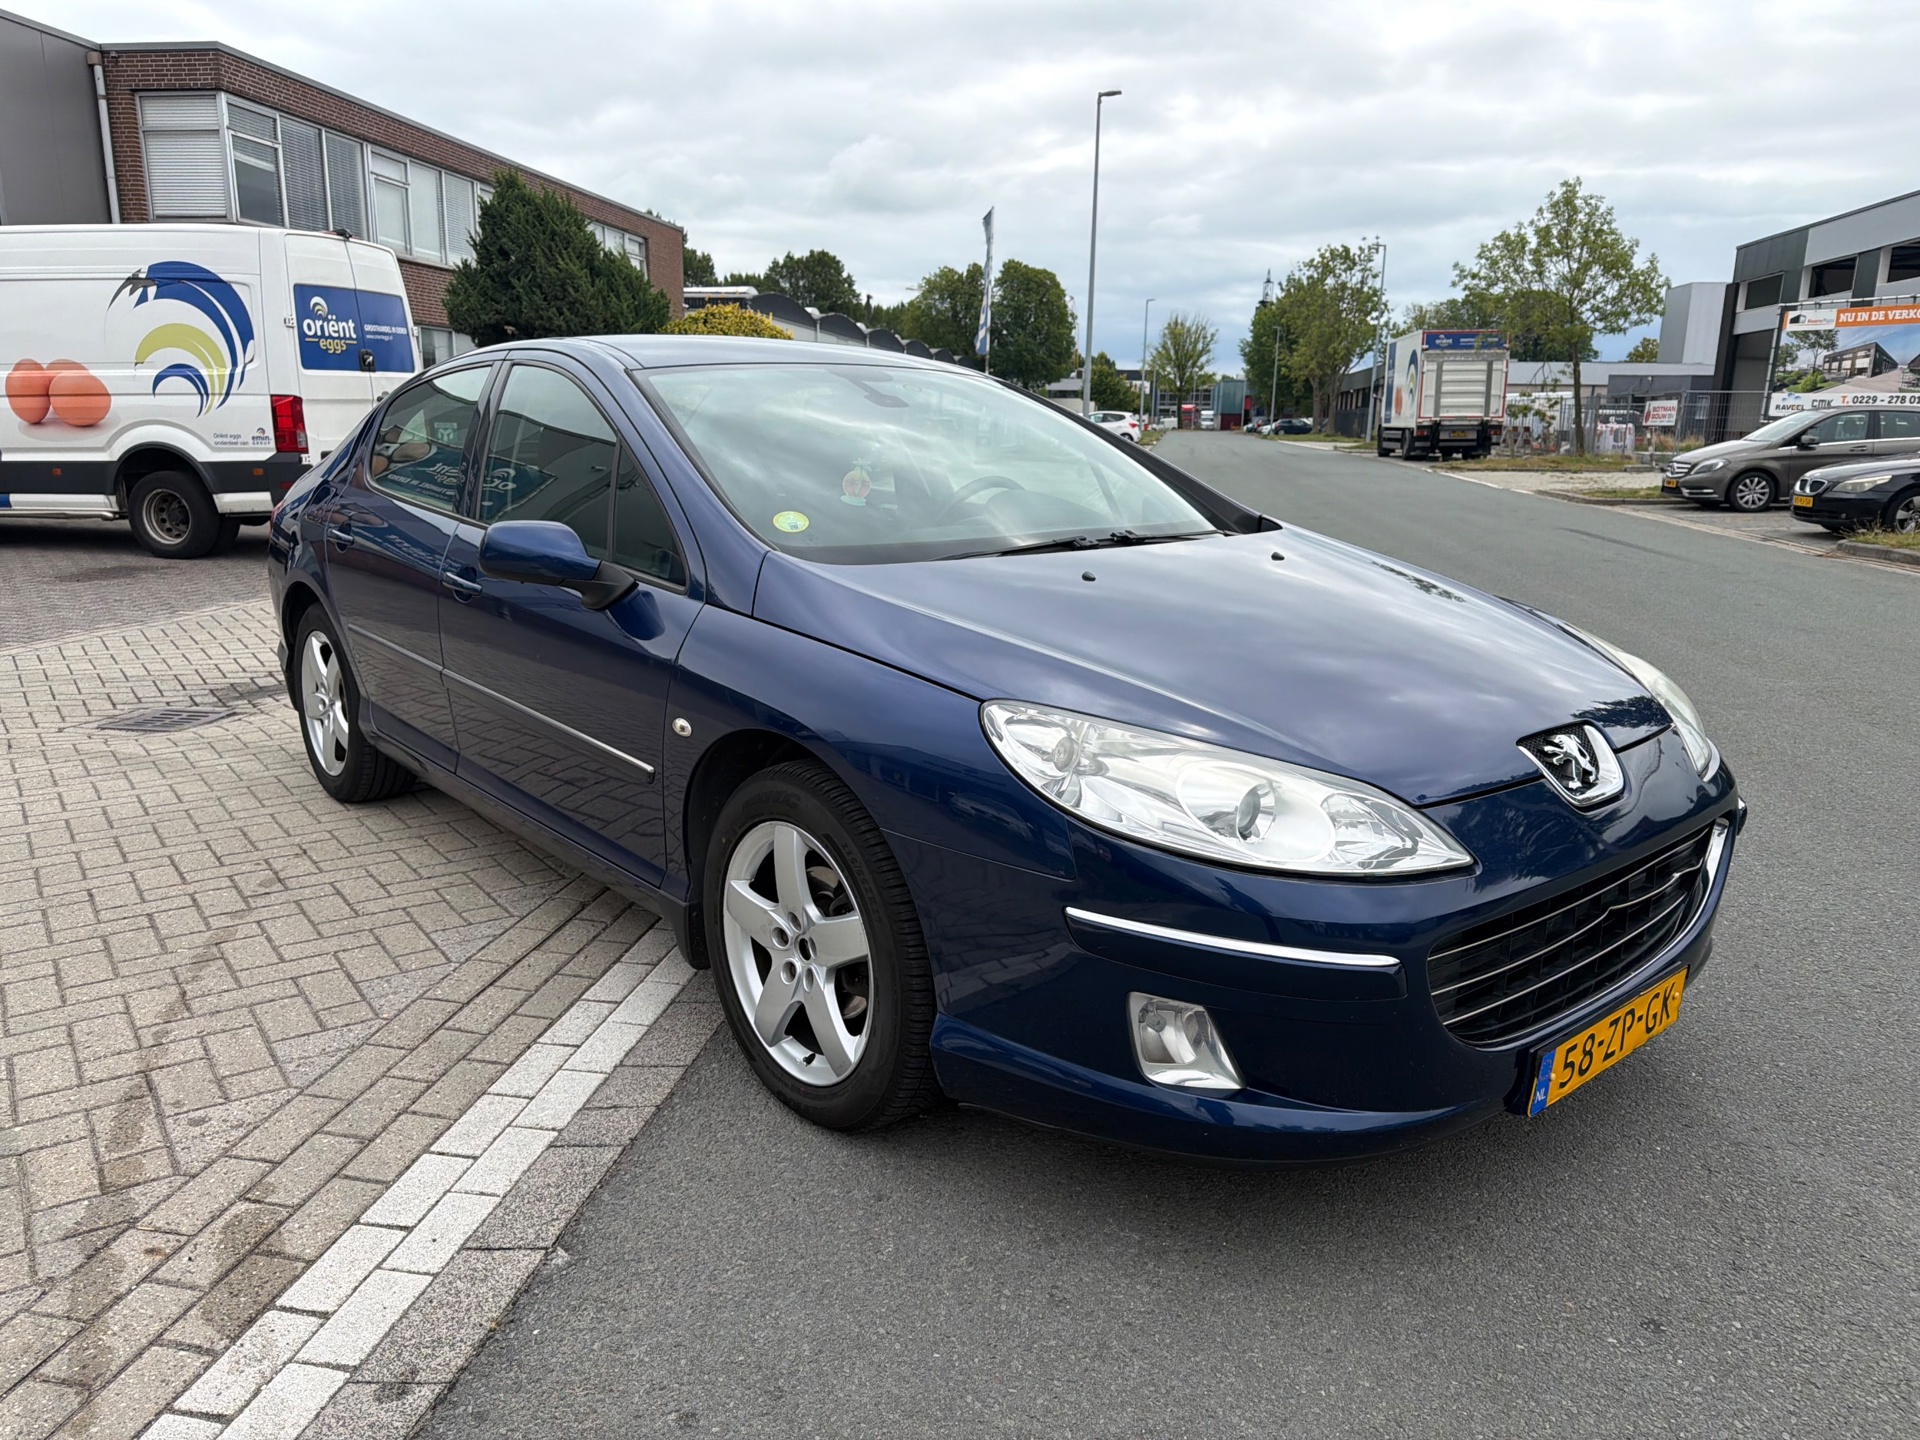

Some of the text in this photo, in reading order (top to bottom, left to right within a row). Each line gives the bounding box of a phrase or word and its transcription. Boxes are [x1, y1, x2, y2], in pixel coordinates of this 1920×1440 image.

[1839, 312, 1855, 323] NU
[1857, 311, 1870, 322] IN
[1871, 310, 1886, 321] DE
[303, 314, 357, 339] oriënt
[319, 338, 347, 354] eggs
[1852, 395, 1878, 405] 0229
[1887, 395, 1907, 405] 278
[1558, 981, 1677, 1090] 58-ZP-GK
[1534, 1087, 1547, 1104] NL
